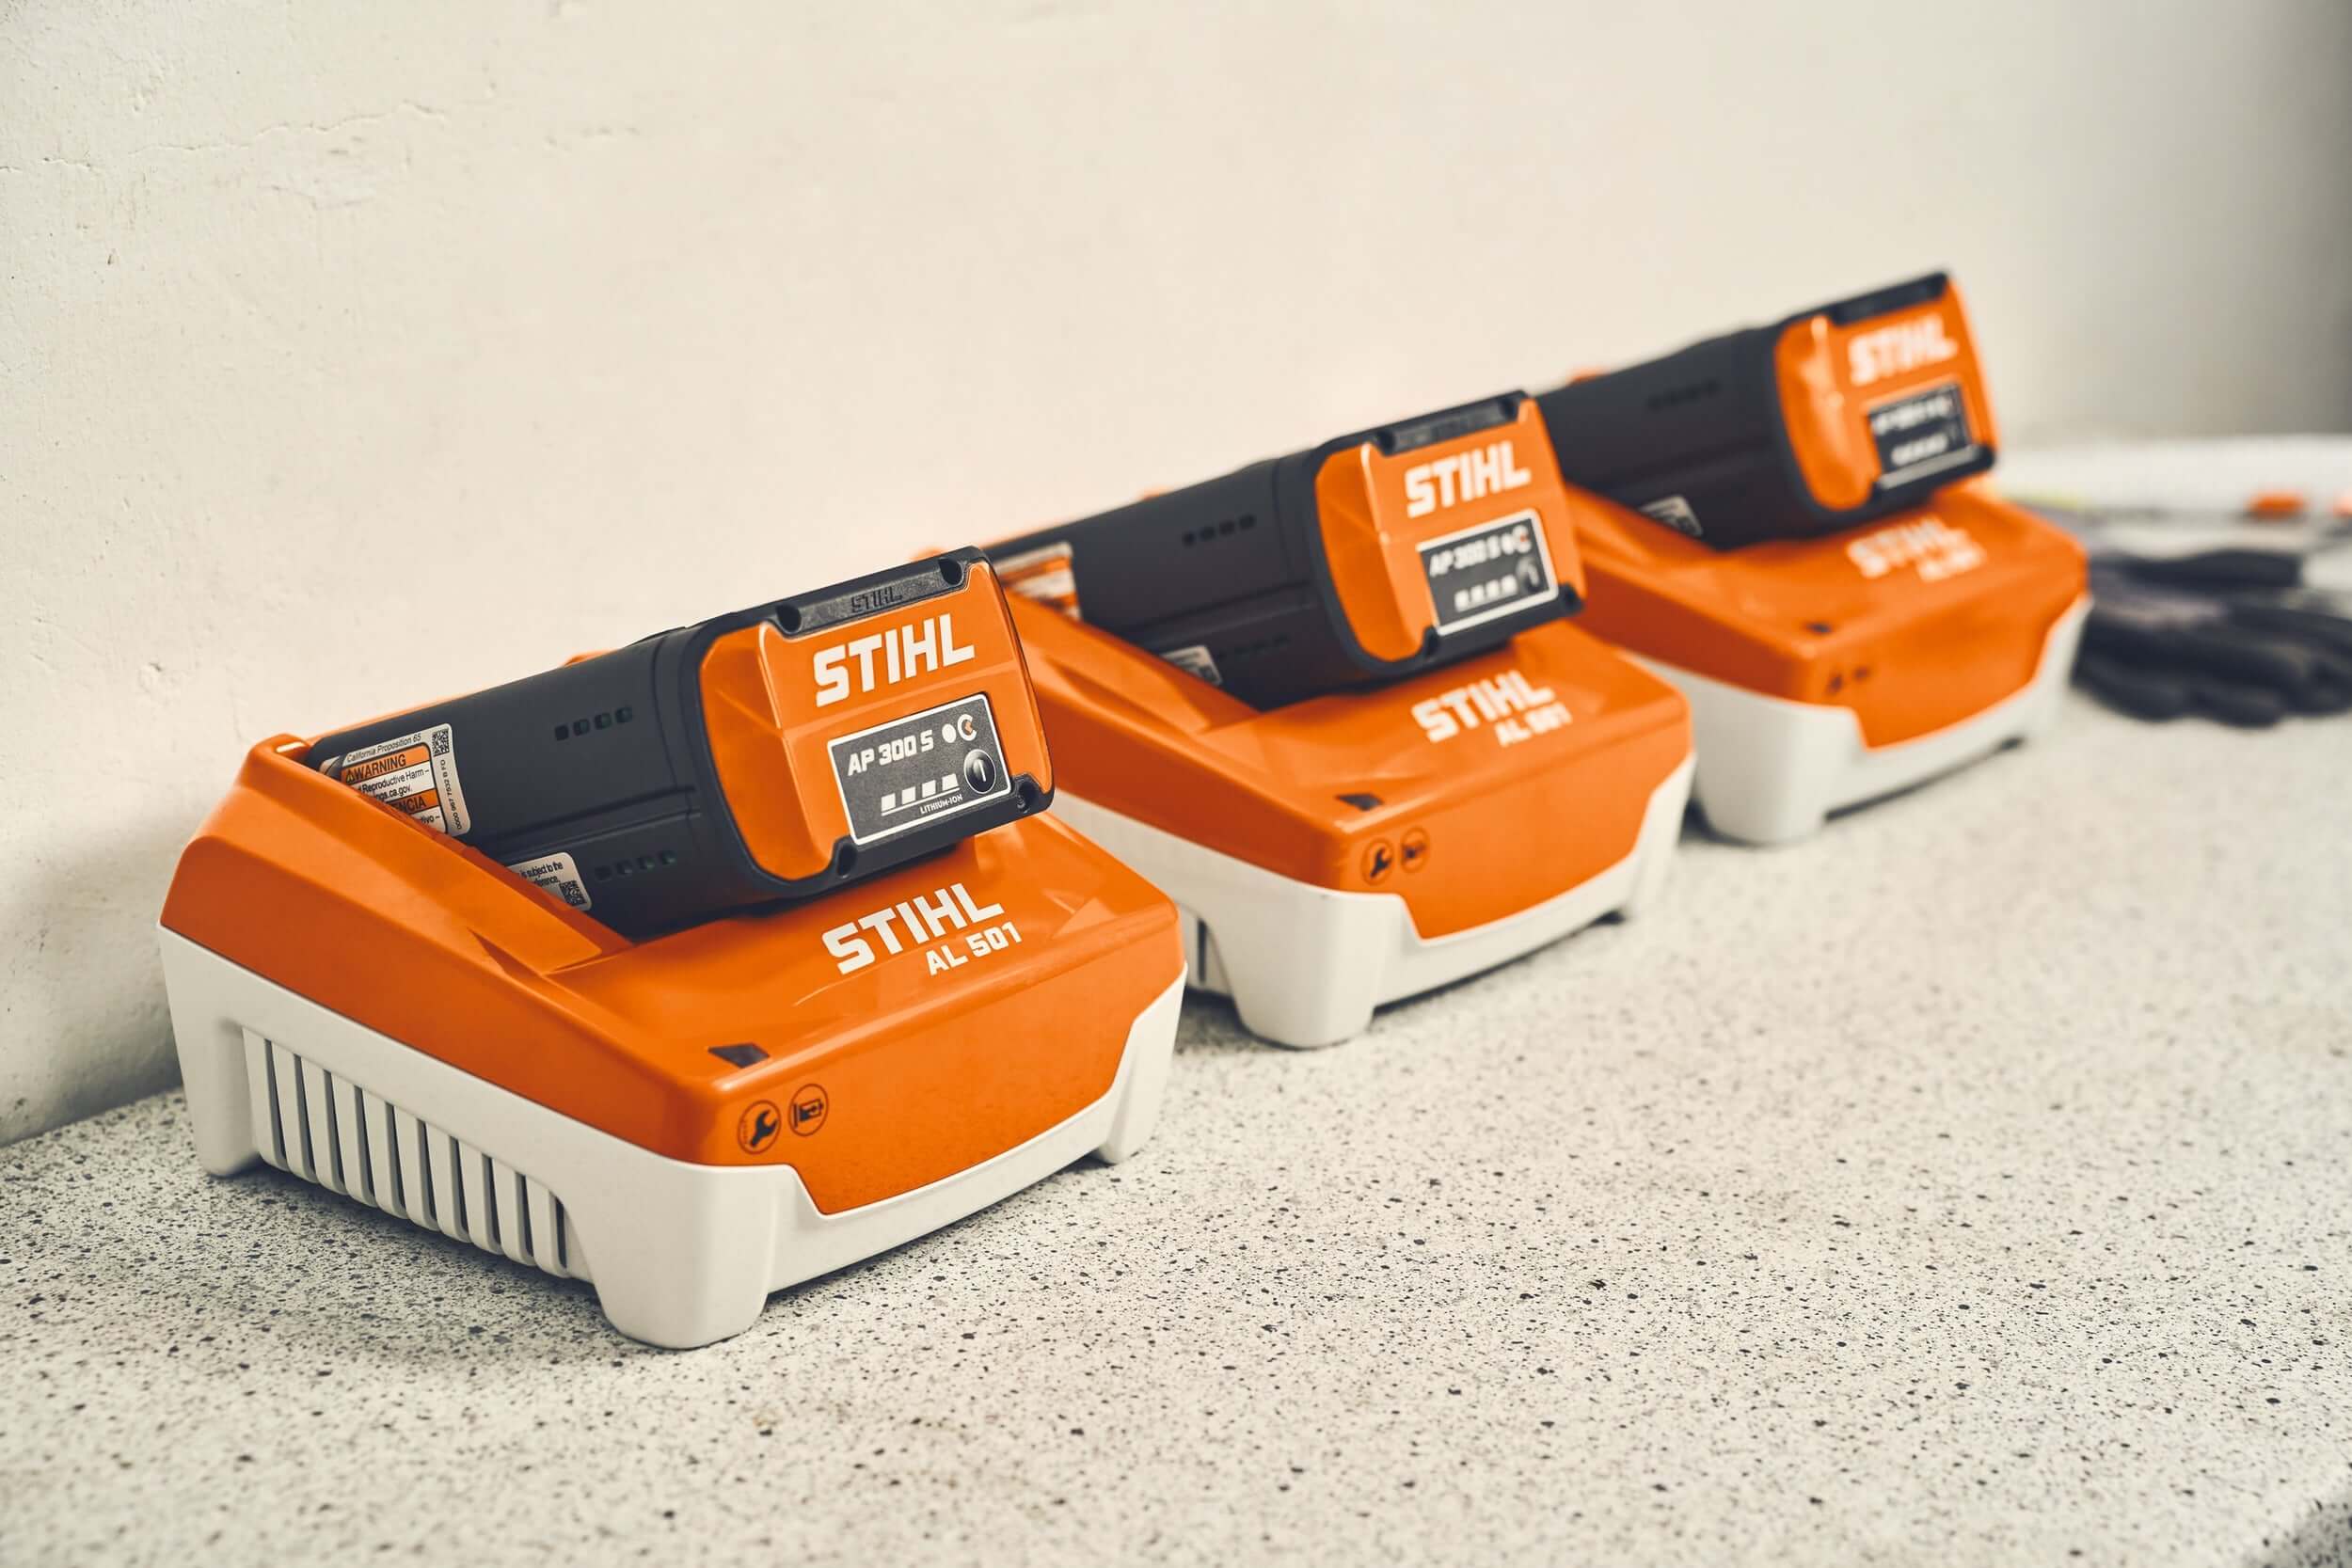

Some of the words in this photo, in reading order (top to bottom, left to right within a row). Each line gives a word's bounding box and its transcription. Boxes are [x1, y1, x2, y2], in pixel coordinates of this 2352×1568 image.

[1404, 440, 1532, 518] STIHL
[850, 586, 903, 612] STIHL
[813, 612, 976, 707] STIHL
[1411, 670, 1556, 743] STIHL
[347, 748, 376, 763] California
[376, 736, 412, 753] Proposition
[413, 733, 421, 743] 65
[354, 753, 406, 780] WARNING
[848, 748, 875, 777] AP
[879, 736, 917, 767] 300
[920, 729, 934, 753] S
[361, 773, 408, 794] Reproductive
[405, 768, 425, 782] Harm
[821, 883, 1005, 974] STIHL
[926, 944, 969, 975] AL
[965, 921, 1023, 958] 501
